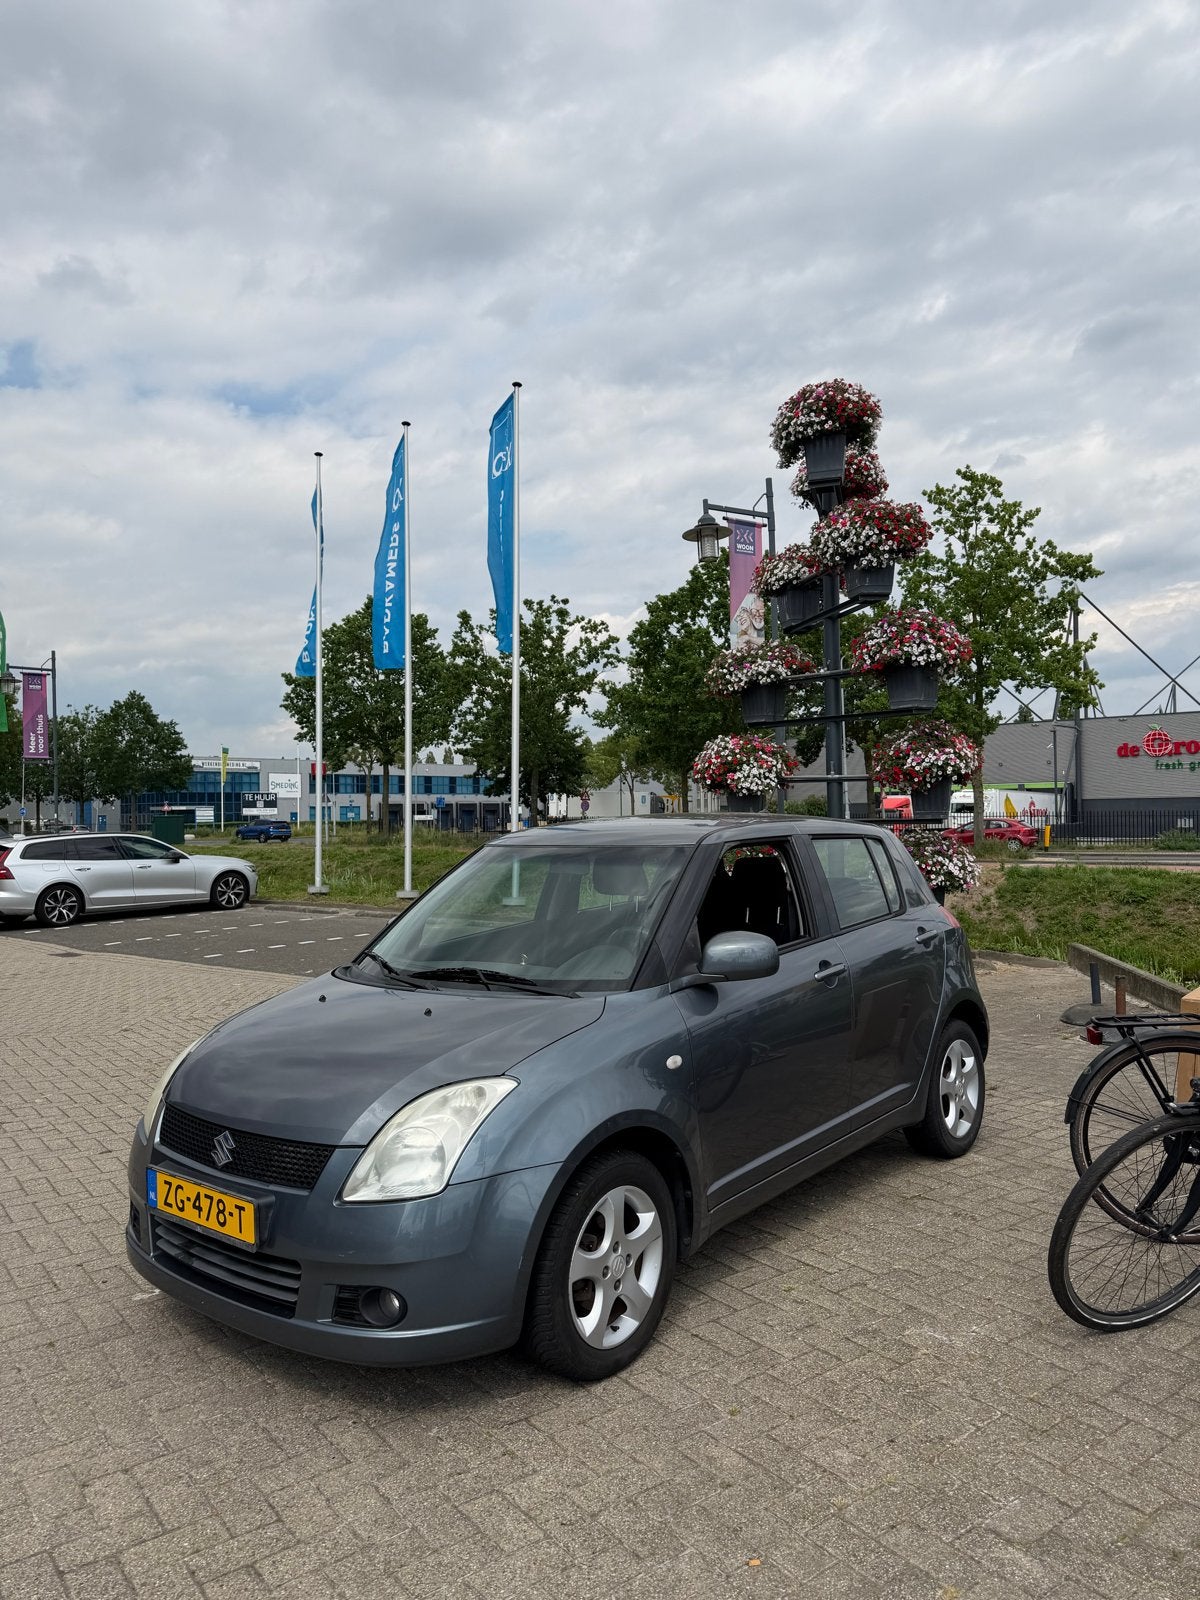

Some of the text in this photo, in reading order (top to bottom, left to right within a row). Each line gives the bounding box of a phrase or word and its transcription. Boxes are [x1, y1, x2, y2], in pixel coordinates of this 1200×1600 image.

[736, 543, 754, 551] WOON
[36, 714, 44, 734] thuis
[1117, 730, 1200, 757] de Gro
[1155, 760, 1184, 770] fresh
[270, 780, 299, 790] SMEDING
[244, 793, 276, 801] TE HUUR
[149, 1191, 157, 1201] NL
[163, 1179, 246, 1234] ZG-478-T
